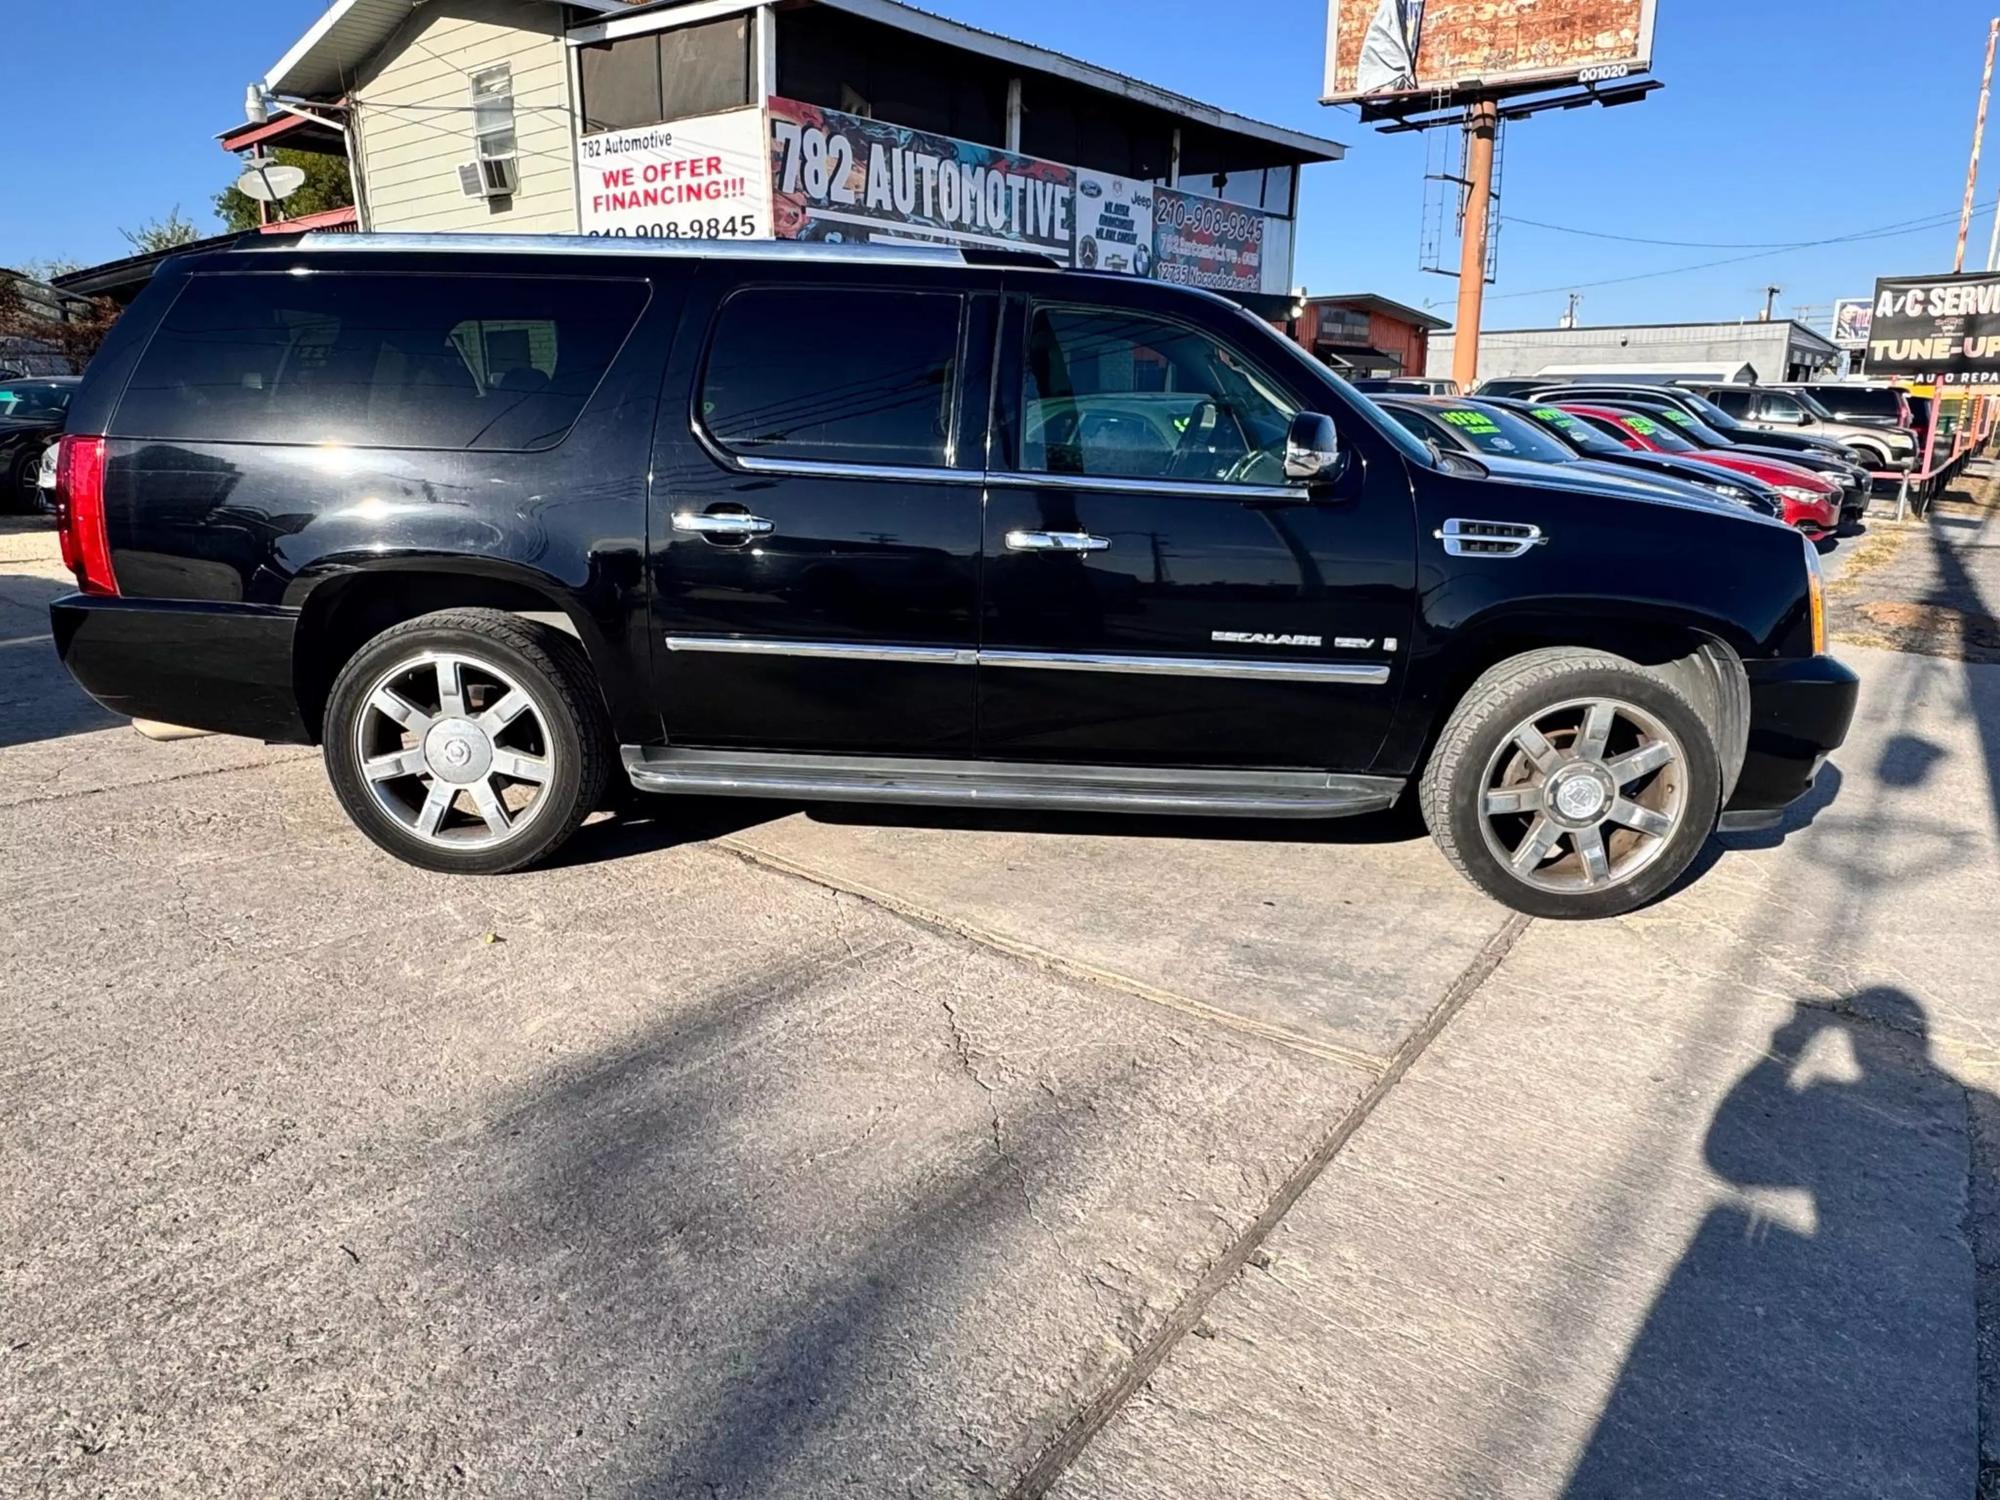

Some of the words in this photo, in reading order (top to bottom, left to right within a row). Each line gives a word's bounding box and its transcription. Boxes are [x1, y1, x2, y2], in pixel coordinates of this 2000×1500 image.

[1578, 64, 1628, 82] 001020
[582, 142, 601, 159] 782
[605, 131, 673, 156] Automotive
[602, 168, 635, 190] WE
[643, 156, 723, 184] OFFER
[775, 121, 855, 205] 782
[866, 142, 1070, 241] AUTOMOTIVE
[593, 177, 746, 214] FINANCING!!!
[1131, 191, 1152, 211] Jeep
[1156, 197, 1264, 243] 210-908-9845
[1157, 261, 1188, 283] 12735
[1875, 288, 1925, 318] A/C
[1870, 335, 2000, 361] TUNE-UP
[1915, 373, 1954, 384] AUO
